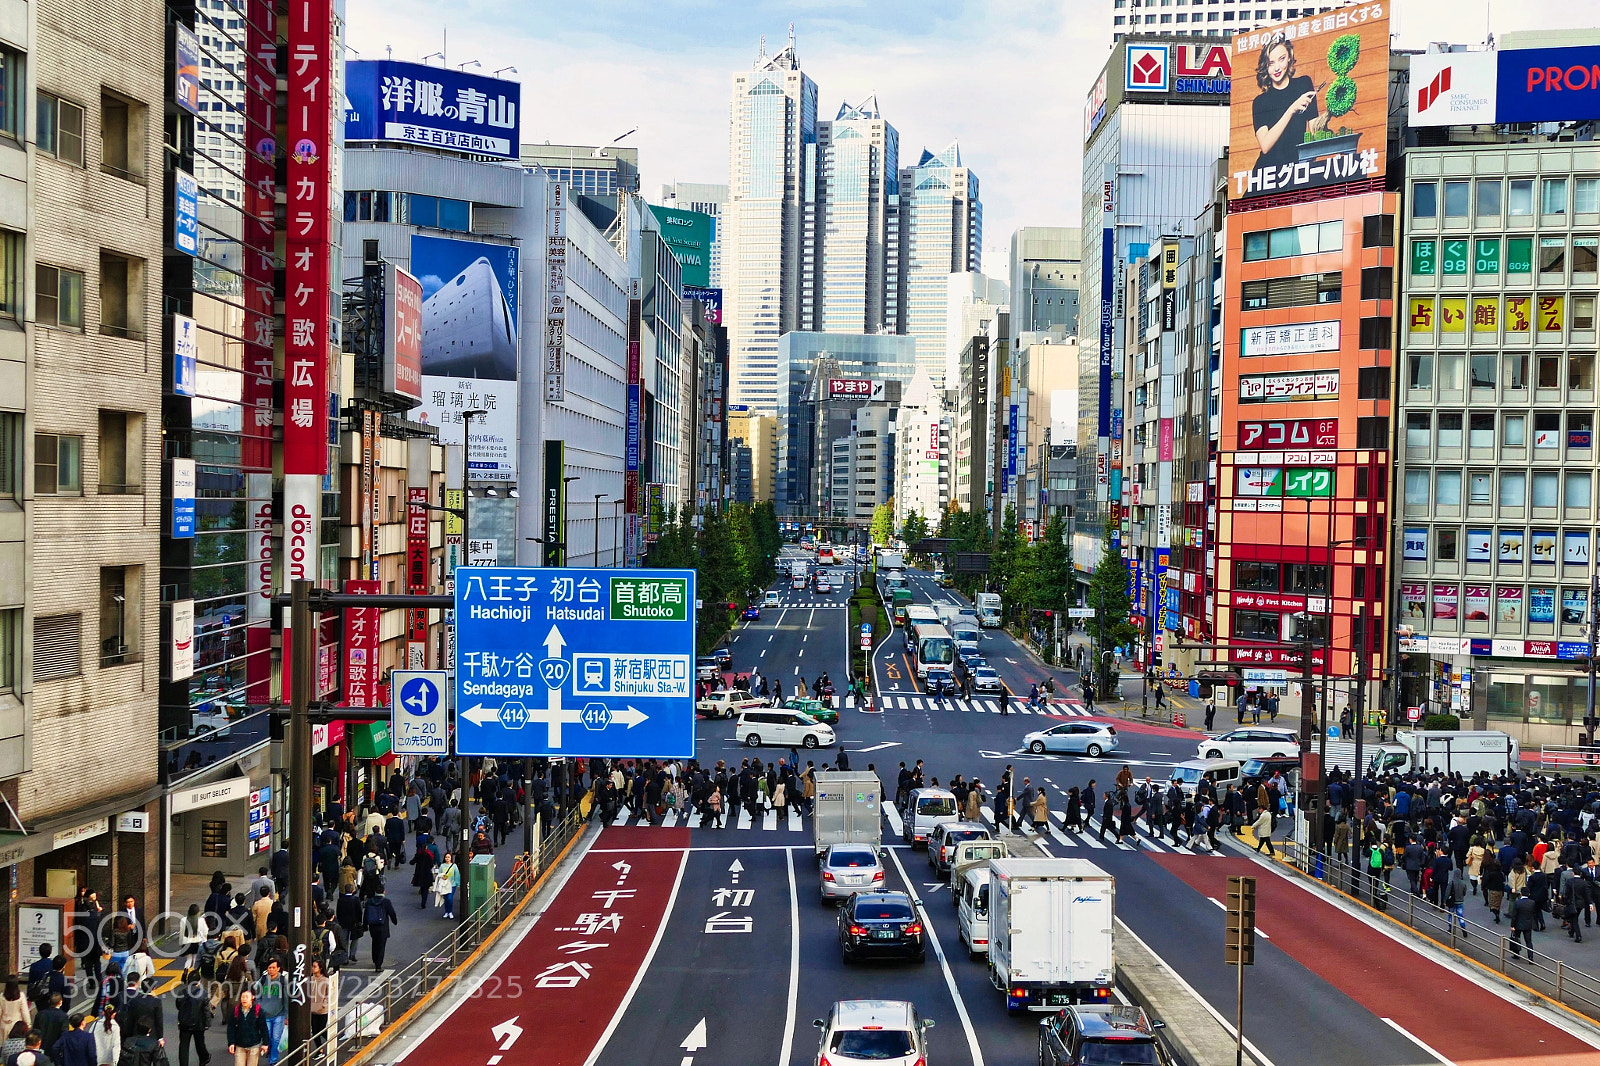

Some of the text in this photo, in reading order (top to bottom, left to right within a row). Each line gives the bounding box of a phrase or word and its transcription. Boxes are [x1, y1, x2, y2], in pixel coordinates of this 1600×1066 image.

[1237, 4, 1383, 51] 世界の不動産を面白くする
[381, 76, 515, 129] 洋服の青山
[403, 126, 496, 150] 京王百貨店向い
[1233, 147, 1379, 194] THEグローバル社
[1416, 241, 1495, 258] ほぐし
[1508, 263, 1531, 271] 60分
[1411, 304, 1496, 326] 占い館
[1250, 326, 1333, 345] 新宿矯正歯科
[978, 342, 987, 404] ホウライビル
[458, 381, 472, 390] 新宿
[832, 381, 869, 392] やまや
[1266, 381, 1338, 395] エーアイアール
[432, 391, 497, 410] 瑠璃光院
[628, 399, 638, 467] JAPAN TOTAL CLUB
[1244, 421, 1334, 445] アコム 6F
[1287, 454, 1307, 462] アコム
[1314, 454, 1333, 462] アコム
[1286, 472, 1329, 490] レイク
[291, 504, 312, 579] docom
[469, 541, 493, 554] 集中
[1405, 541, 1425, 551] 賃貸
[463, 576, 683, 604] 八王子 初台 首都高
[470, 605, 674, 622] Hachioji Hatsudai Shutoko
[545, 664, 564, 680] 20
[614, 657, 686, 680] 新宿駅西口
[463, 680, 686, 698] Sendagaya Shinjuku Sta.-W.
[502, 707, 524, 722] 414
[585, 708, 607, 724] 414
[397, 735, 443, 747] この先50m
[200, 787, 232, 801] SUIT SELECT
[705, 888, 755, 933] 初台
